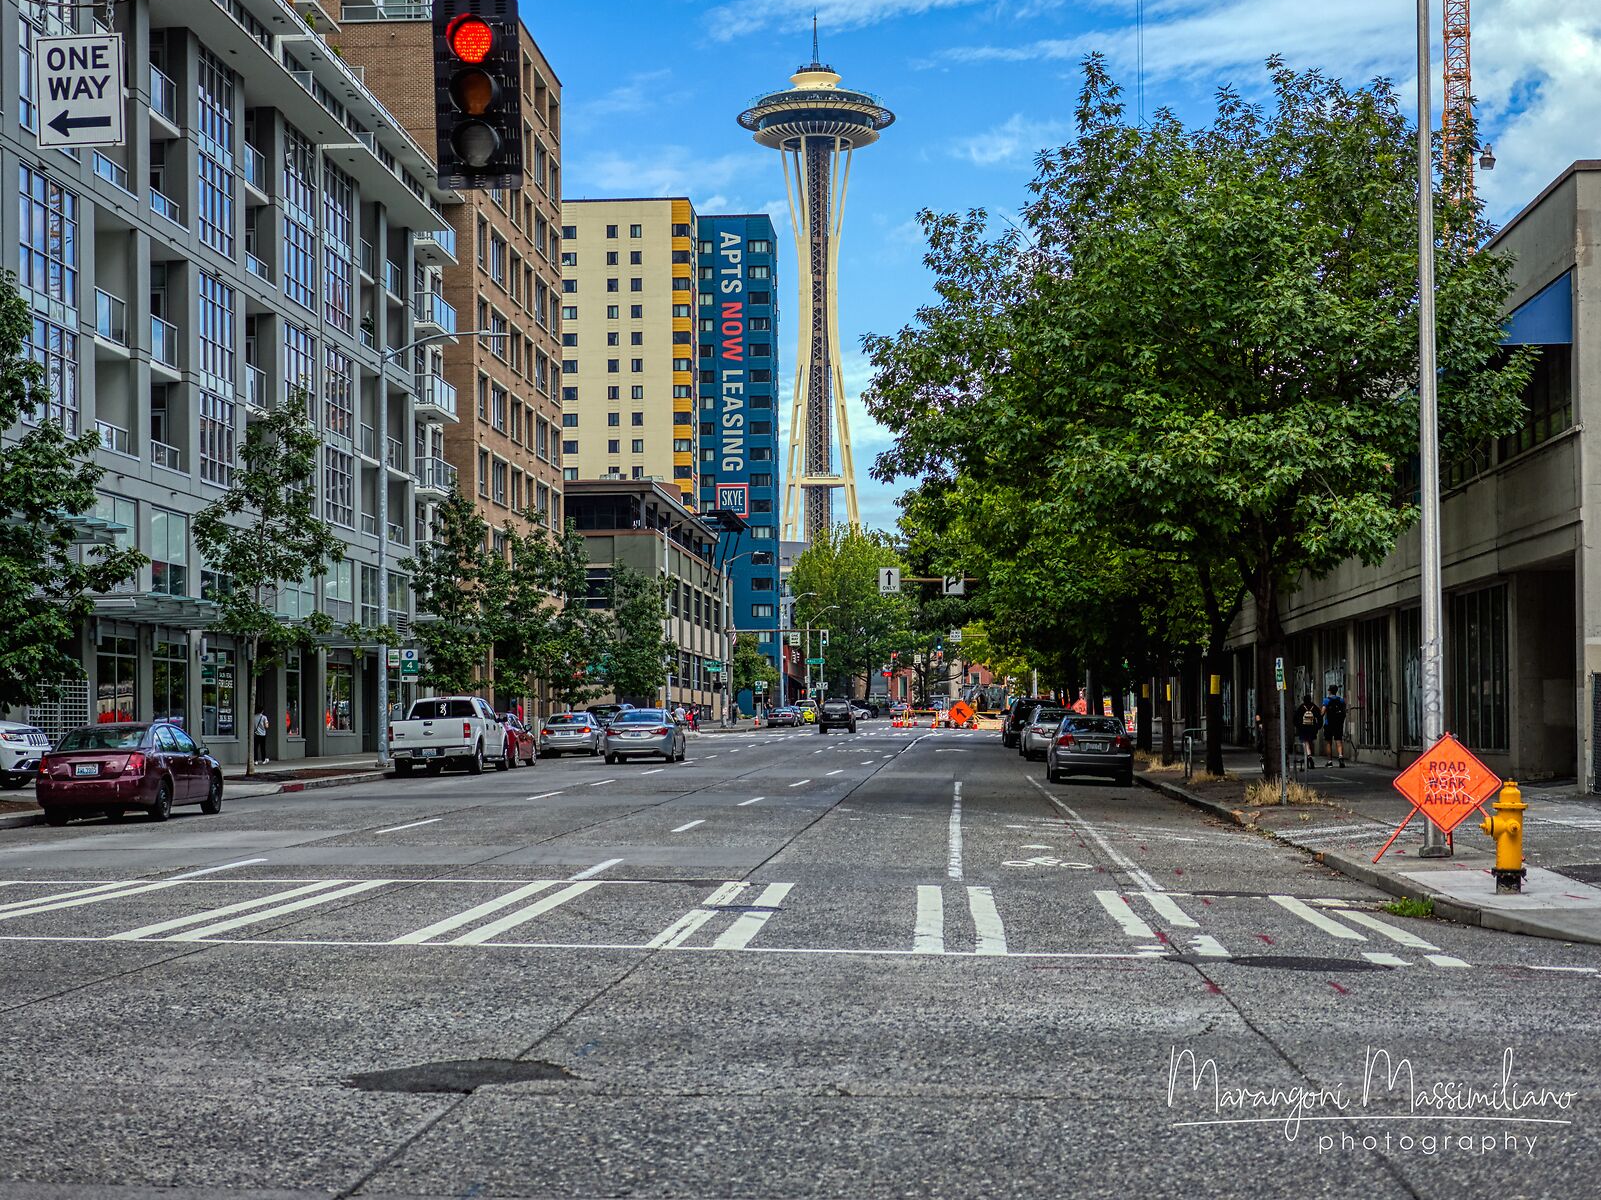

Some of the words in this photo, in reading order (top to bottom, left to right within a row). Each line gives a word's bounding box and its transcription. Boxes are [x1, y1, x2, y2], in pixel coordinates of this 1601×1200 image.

[47, 45, 109, 71] ONE
[48, 75, 111, 101] WAY
[720, 232, 742, 293] APTS
[721, 302, 743, 361] NOW
[722, 369, 744, 472] LEASING
[722, 490, 743, 506] SKYE
[407, 661, 413, 669] 4
[1429, 761, 1466, 772] ROAD
[1428, 777, 1466, 789] WORK
[1424, 793, 1471, 805] AHEAD
